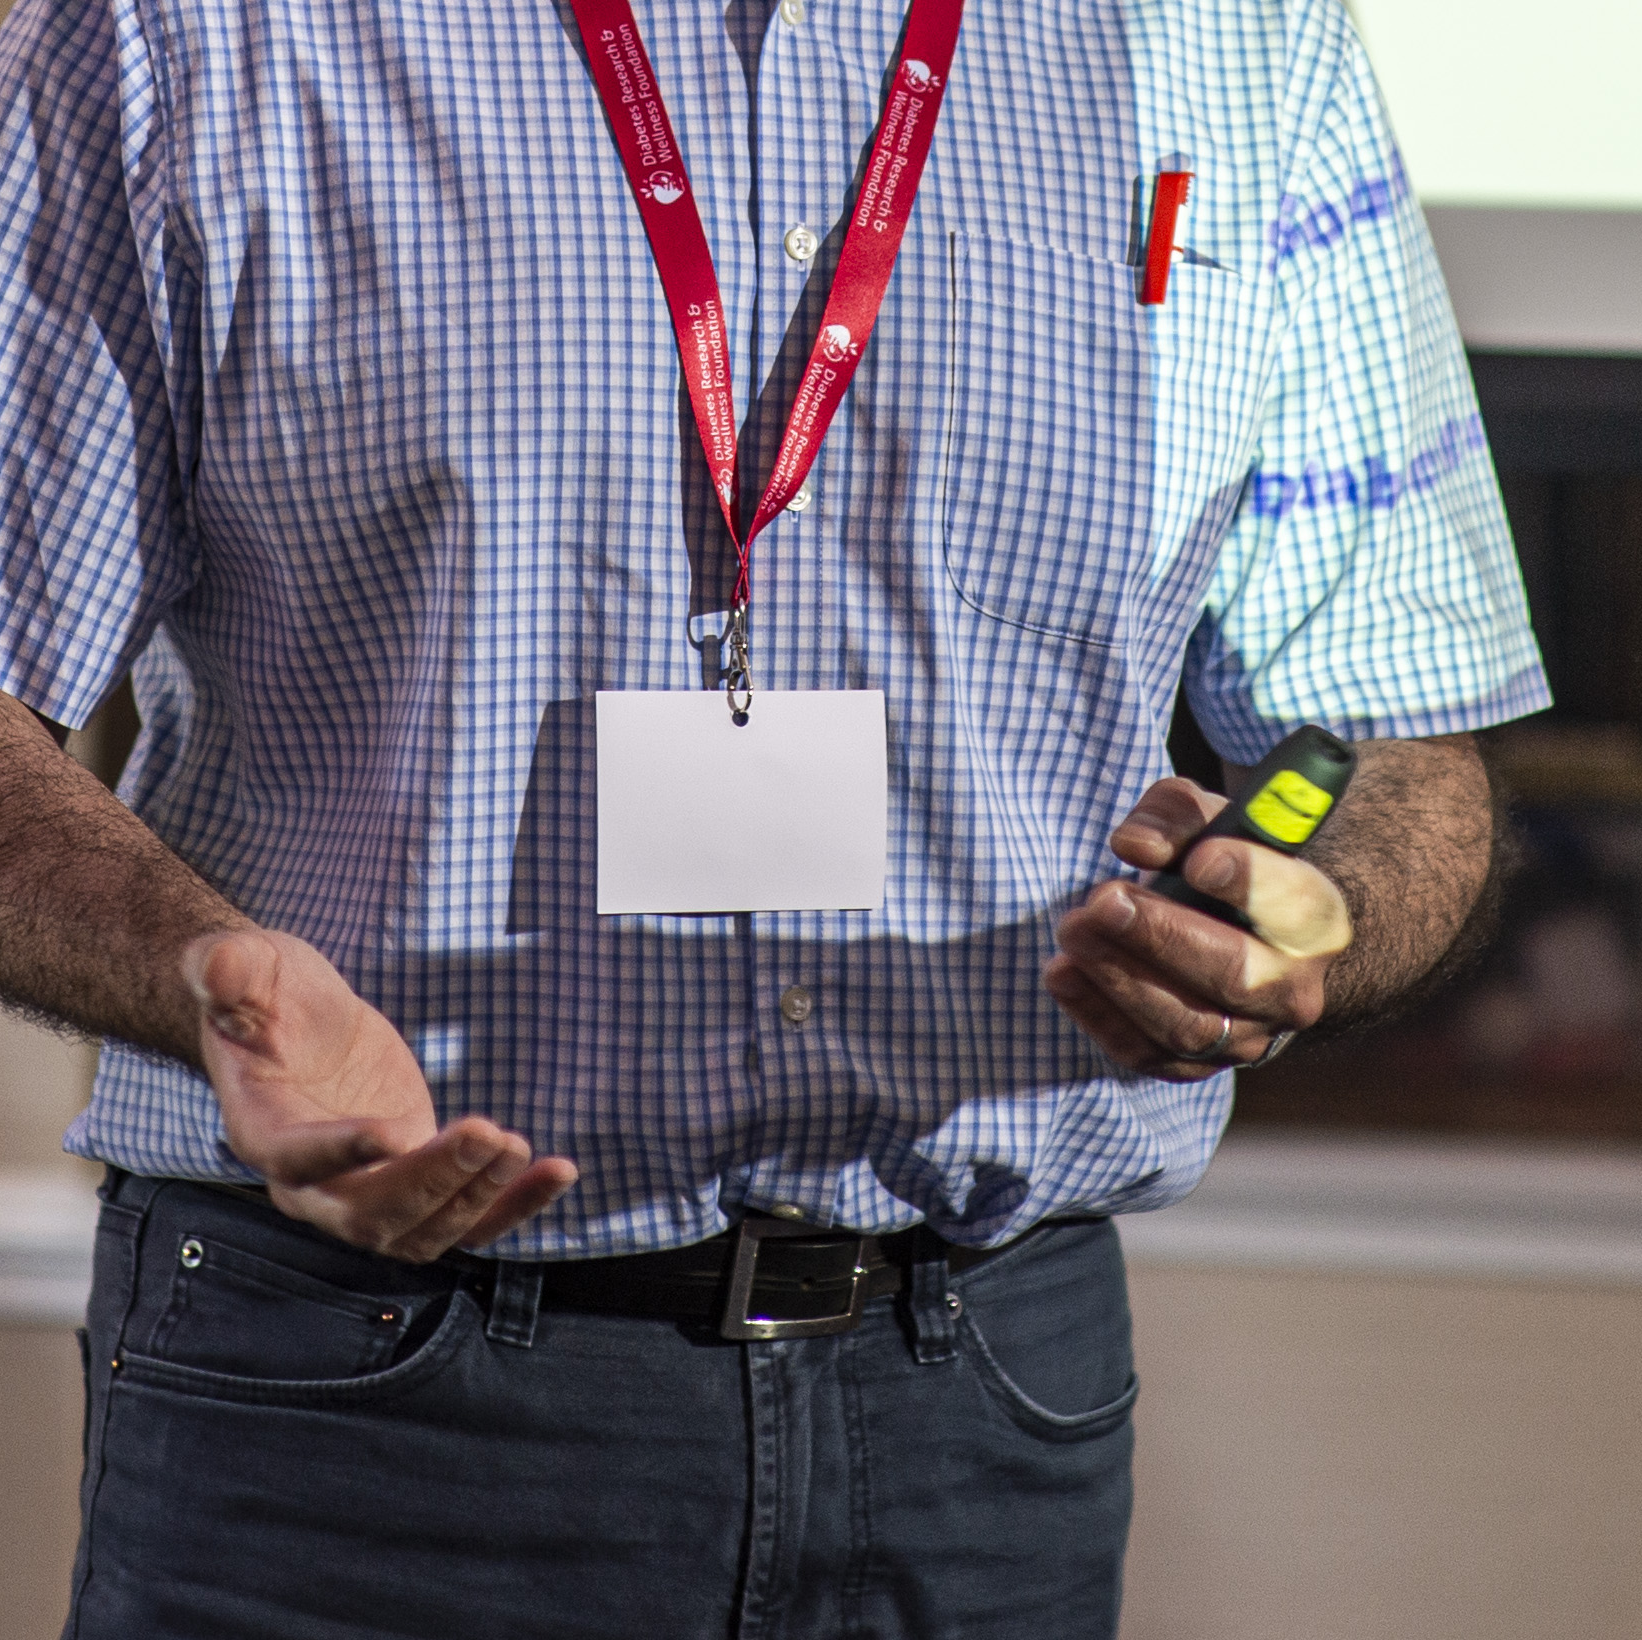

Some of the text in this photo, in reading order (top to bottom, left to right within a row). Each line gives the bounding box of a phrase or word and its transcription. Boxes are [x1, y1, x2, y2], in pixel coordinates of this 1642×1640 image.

[600, 29, 657, 167] Diabetes Research &
[619, 23, 673, 164] Wellness Foundation
[857, 90, 908, 227] Wellness Foundation
[873, 96, 924, 233] Diabetes Research &
[688, 304, 725, 461] Diabetes Research &
[705, 300, 734, 460] Wellness Foundation
[761, 362, 824, 510] Wellness Foundation
[802, 368, 837, 432] Diabetes
[776, 434, 808, 500] Research
